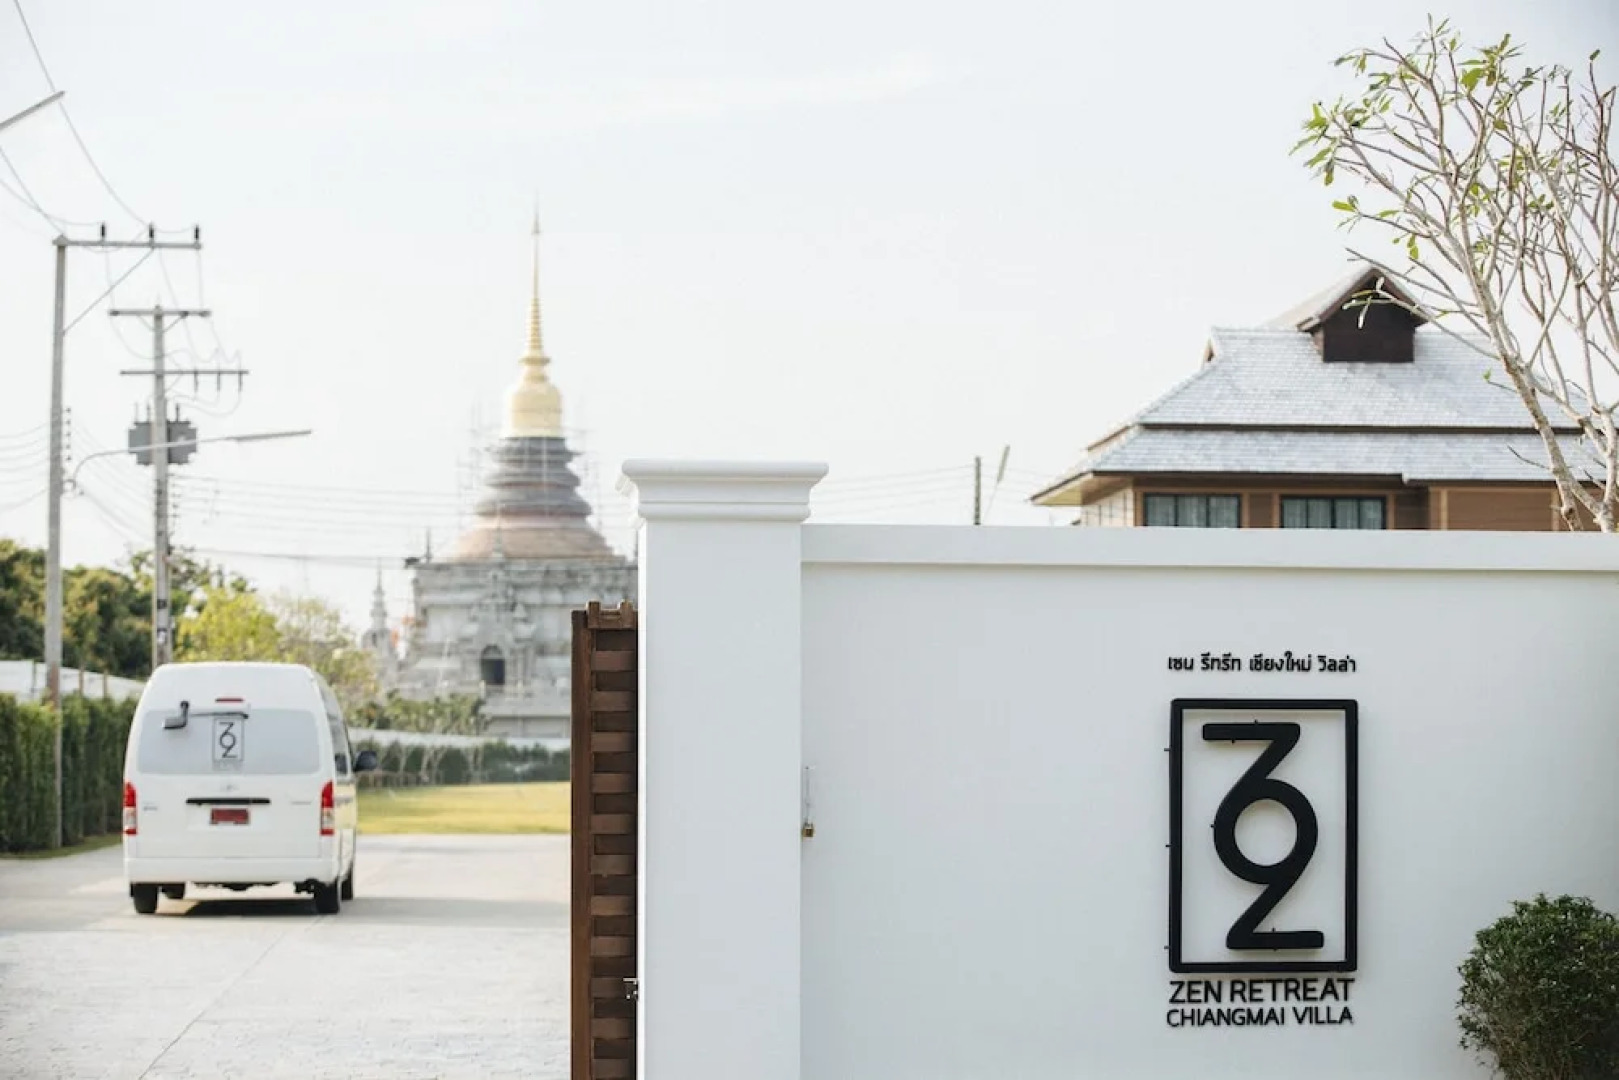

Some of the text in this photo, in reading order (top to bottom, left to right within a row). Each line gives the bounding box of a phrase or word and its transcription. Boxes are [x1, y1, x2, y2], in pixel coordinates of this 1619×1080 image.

[1249, 650, 1313, 673] เชียงใหม่
[1317, 654, 1357, 673] วิลล่า
[1168, 977, 1356, 1004] ZEN RETREAT
[1166, 1006, 1354, 1028] CHIANGMAI VILLA
